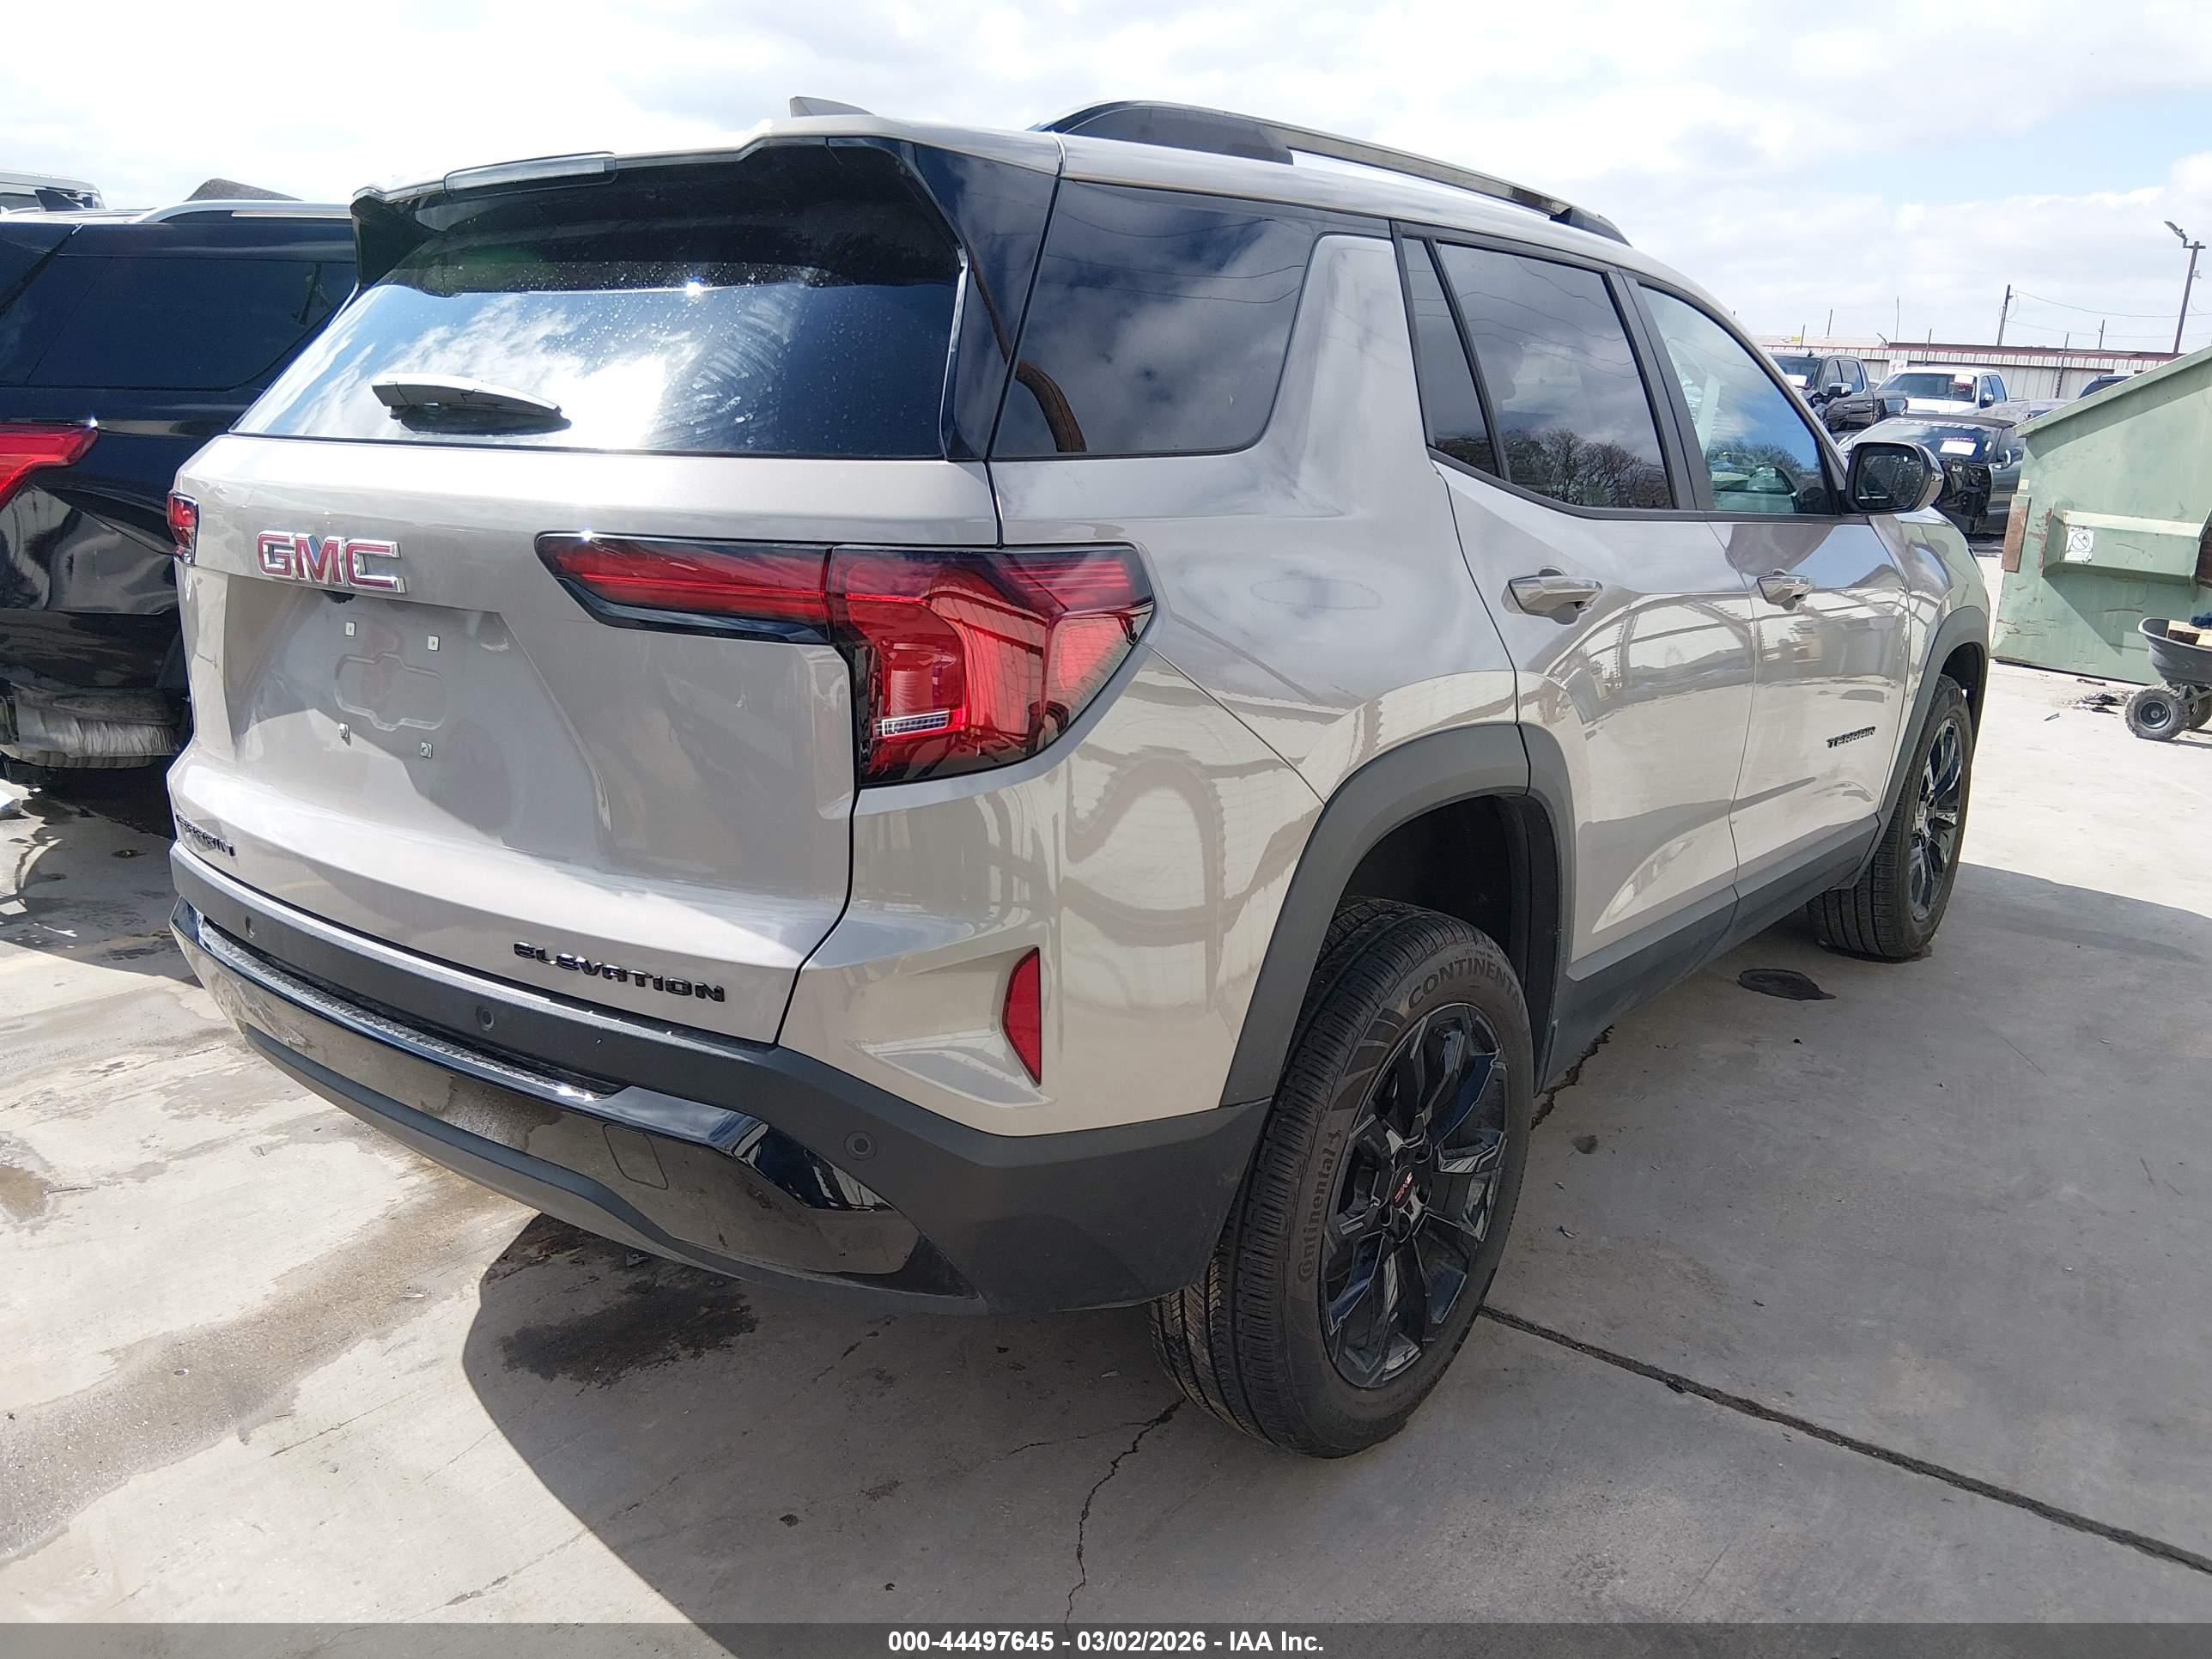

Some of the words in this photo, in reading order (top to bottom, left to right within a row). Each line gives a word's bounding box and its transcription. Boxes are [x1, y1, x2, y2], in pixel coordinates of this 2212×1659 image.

[257, 530, 405, 593] GMC
[1826, 726, 1875, 748] TERRAIN
[514, 941, 726, 1002] ELEVATION
[1298, 1148, 1337, 1282] Continental
